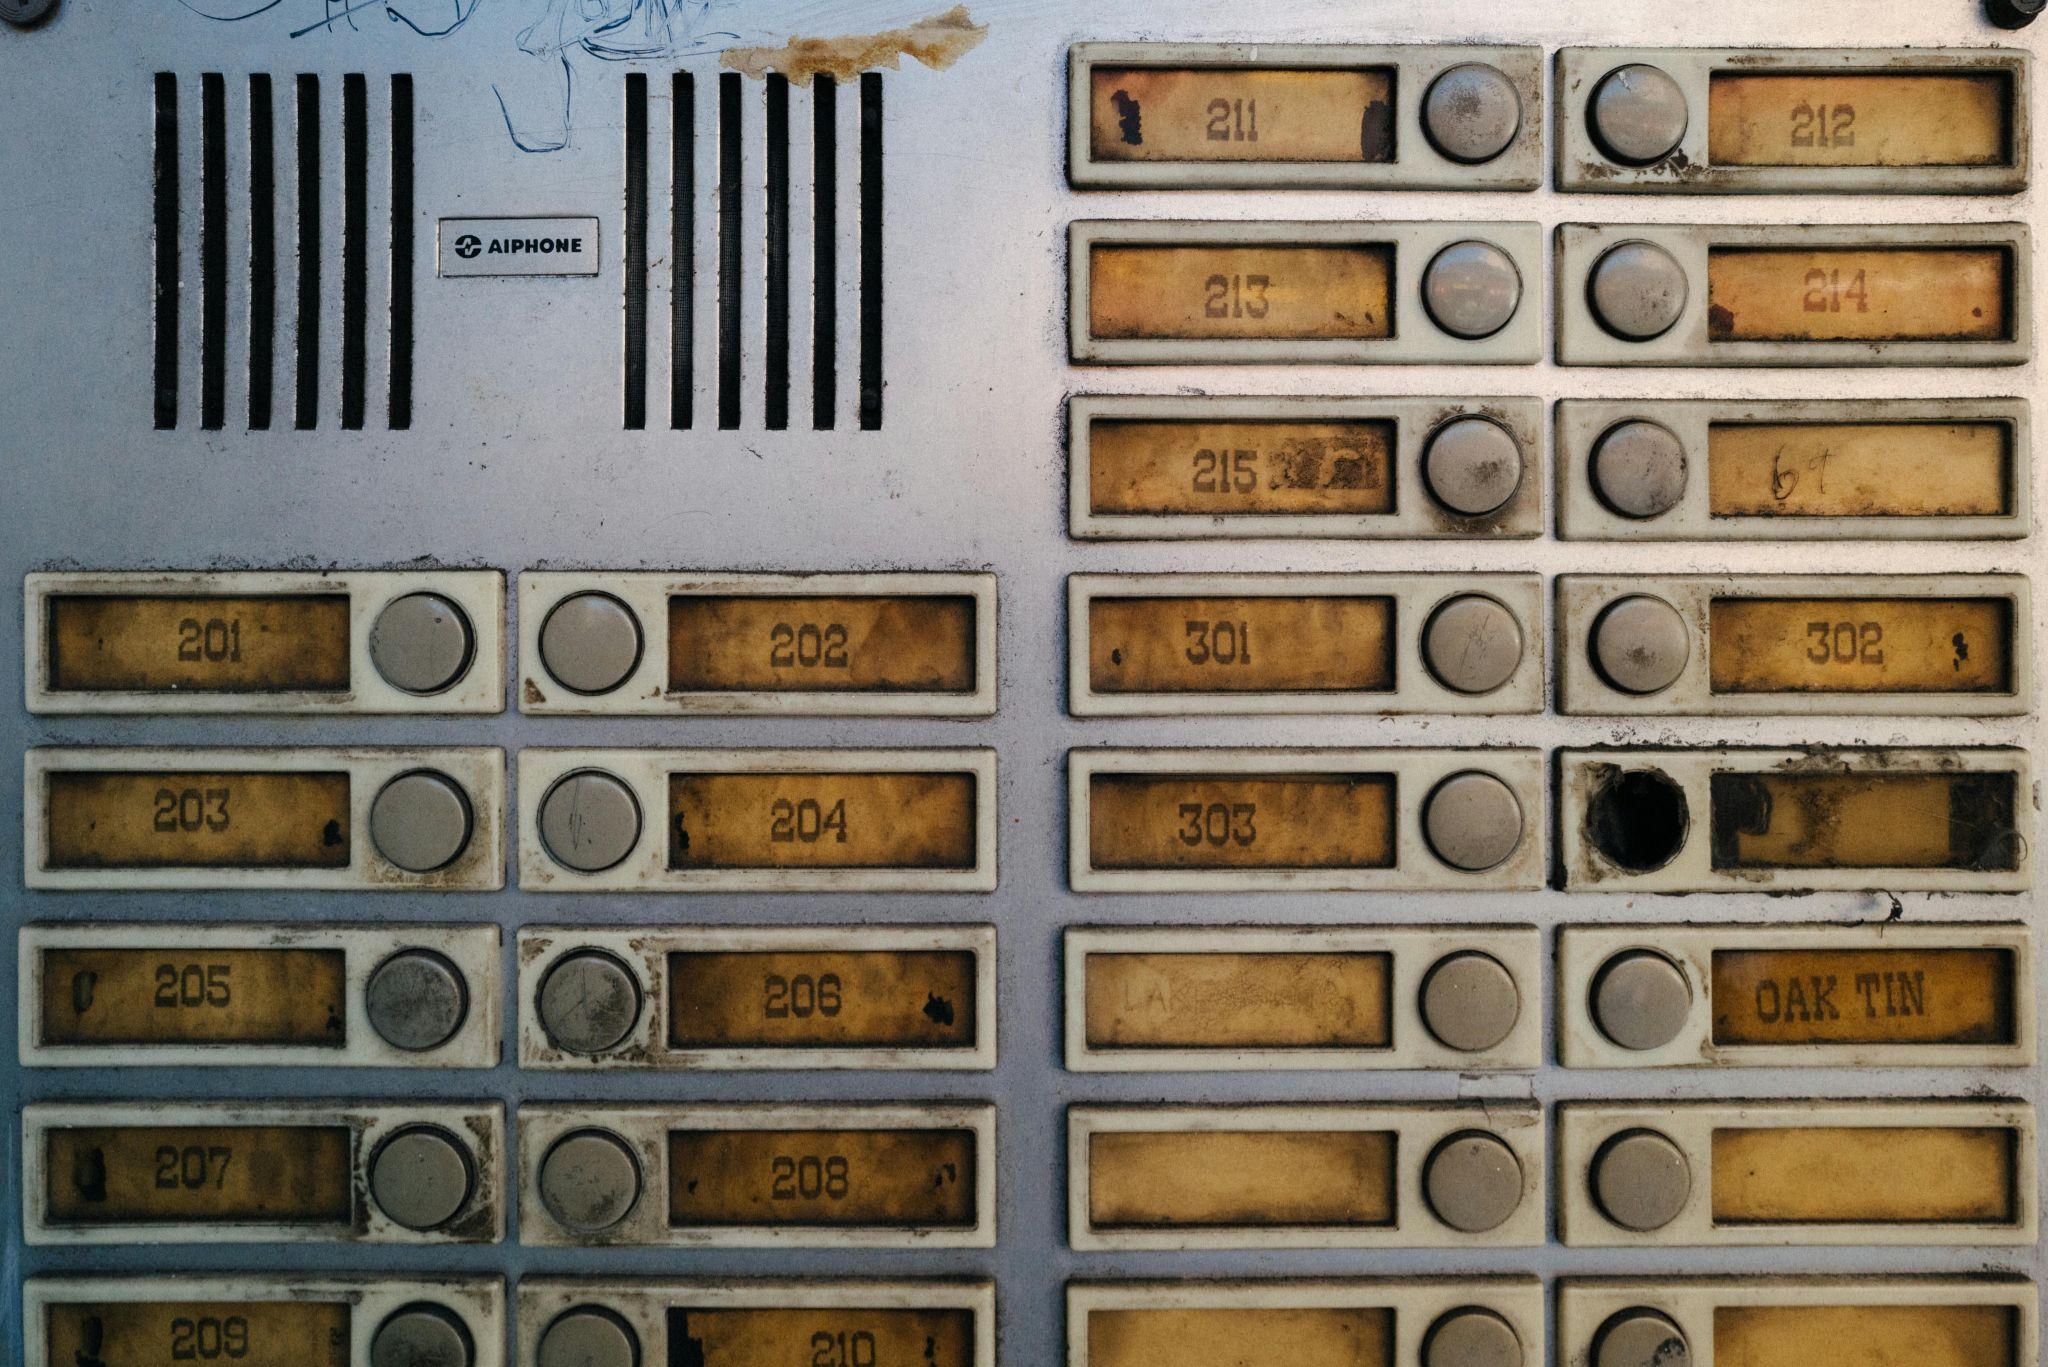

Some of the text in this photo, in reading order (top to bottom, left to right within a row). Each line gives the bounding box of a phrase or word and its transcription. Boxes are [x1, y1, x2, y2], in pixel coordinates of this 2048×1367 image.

[1205, 98, 1259, 142] 211
[1790, 104, 1856, 148] 212
[488, 238, 582, 254] AIPHONE
[1204, 274, 1270, 319] 213
[1803, 268, 1869, 313] 214
[1191, 449, 1258, 494] 215
[177, 618, 242, 662] 201
[770, 623, 849, 668] 202
[1185, 621, 1251, 665] 301
[1807, 622, 1883, 666] 302
[153, 789, 231, 833] 203
[770, 799, 848, 843] 204
[1178, 803, 1257, 847] 303
[154, 964, 231, 1009] 205
[764, 974, 842, 1019] 206
[1755, 970, 1926, 1024] OAK TIN
[155, 1146, 232, 1190] 207
[771, 1156, 849, 1200] 208
[171, 1316, 249, 1360] 209
[811, 1330, 876, 1367] 210
